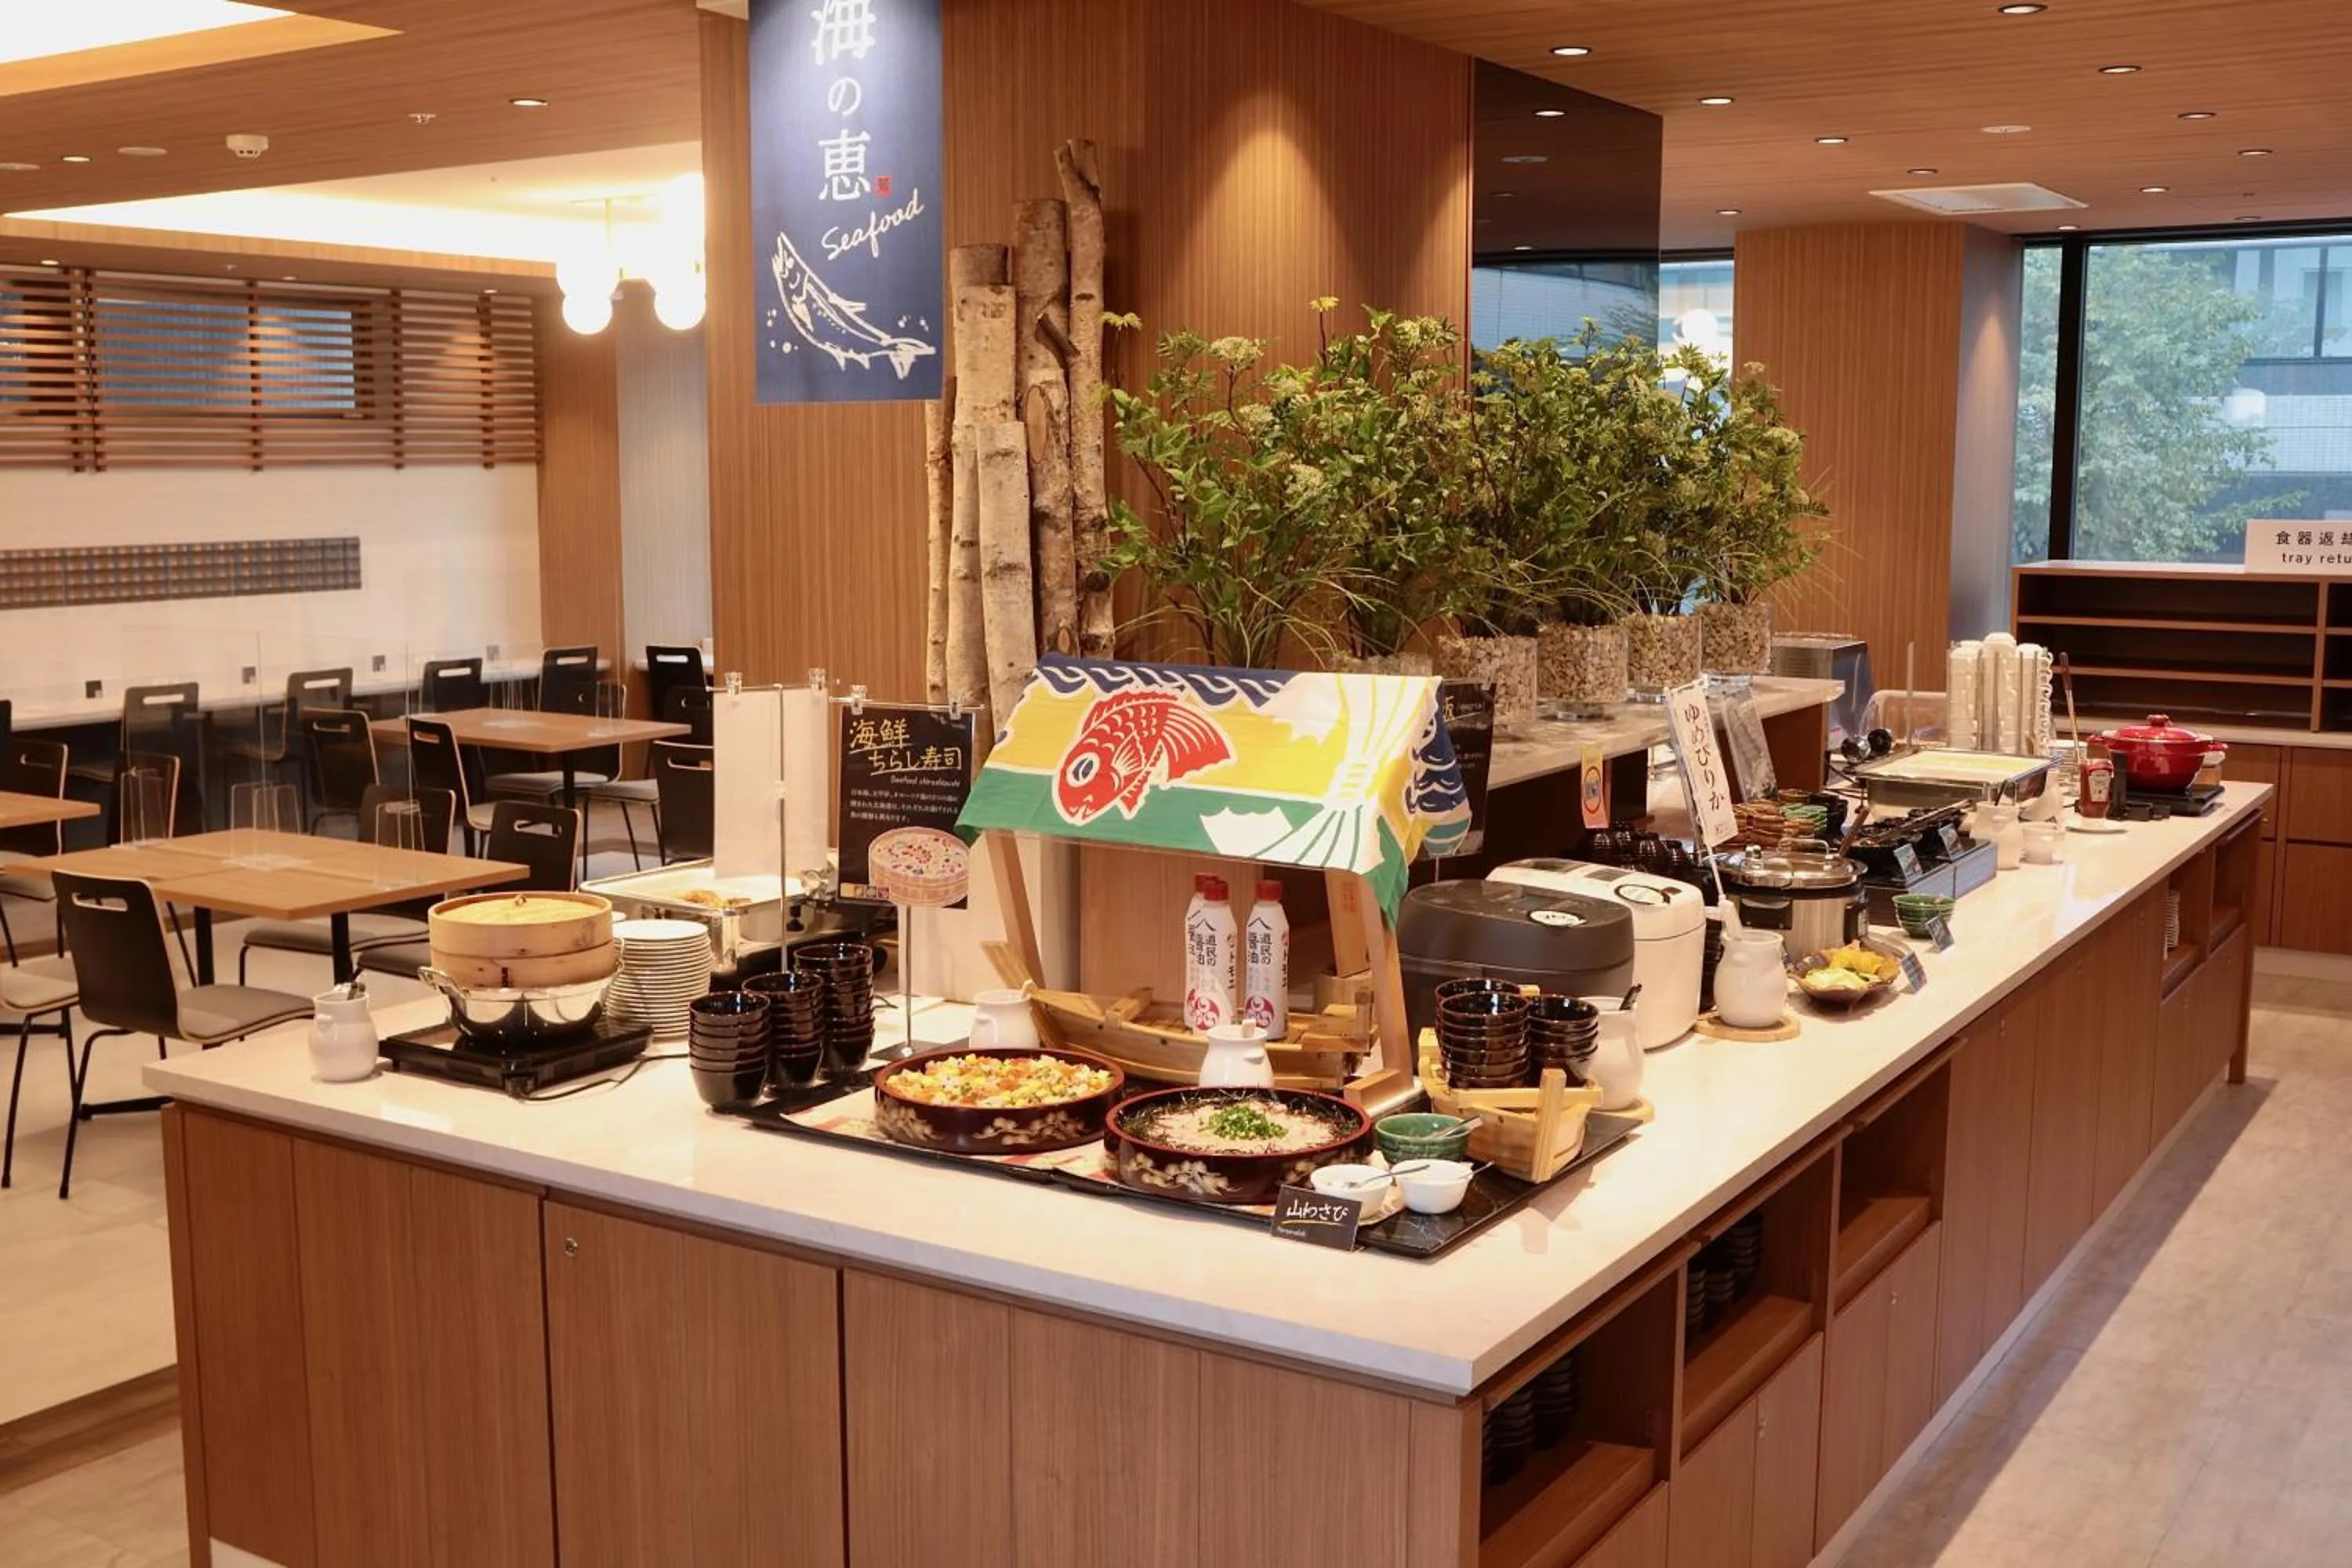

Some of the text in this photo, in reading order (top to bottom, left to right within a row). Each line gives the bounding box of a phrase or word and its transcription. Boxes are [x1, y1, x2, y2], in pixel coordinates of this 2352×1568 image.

[810, 0, 877, 201] 海の恵
[822, 188, 925, 260] Seafood
[2282, 553, 2352, 564] tray retu
[850, 718, 911, 748] 海鮮
[868, 746, 962, 771] ちらし寿司
[1287, 1199, 1348, 1221] 山わさび
